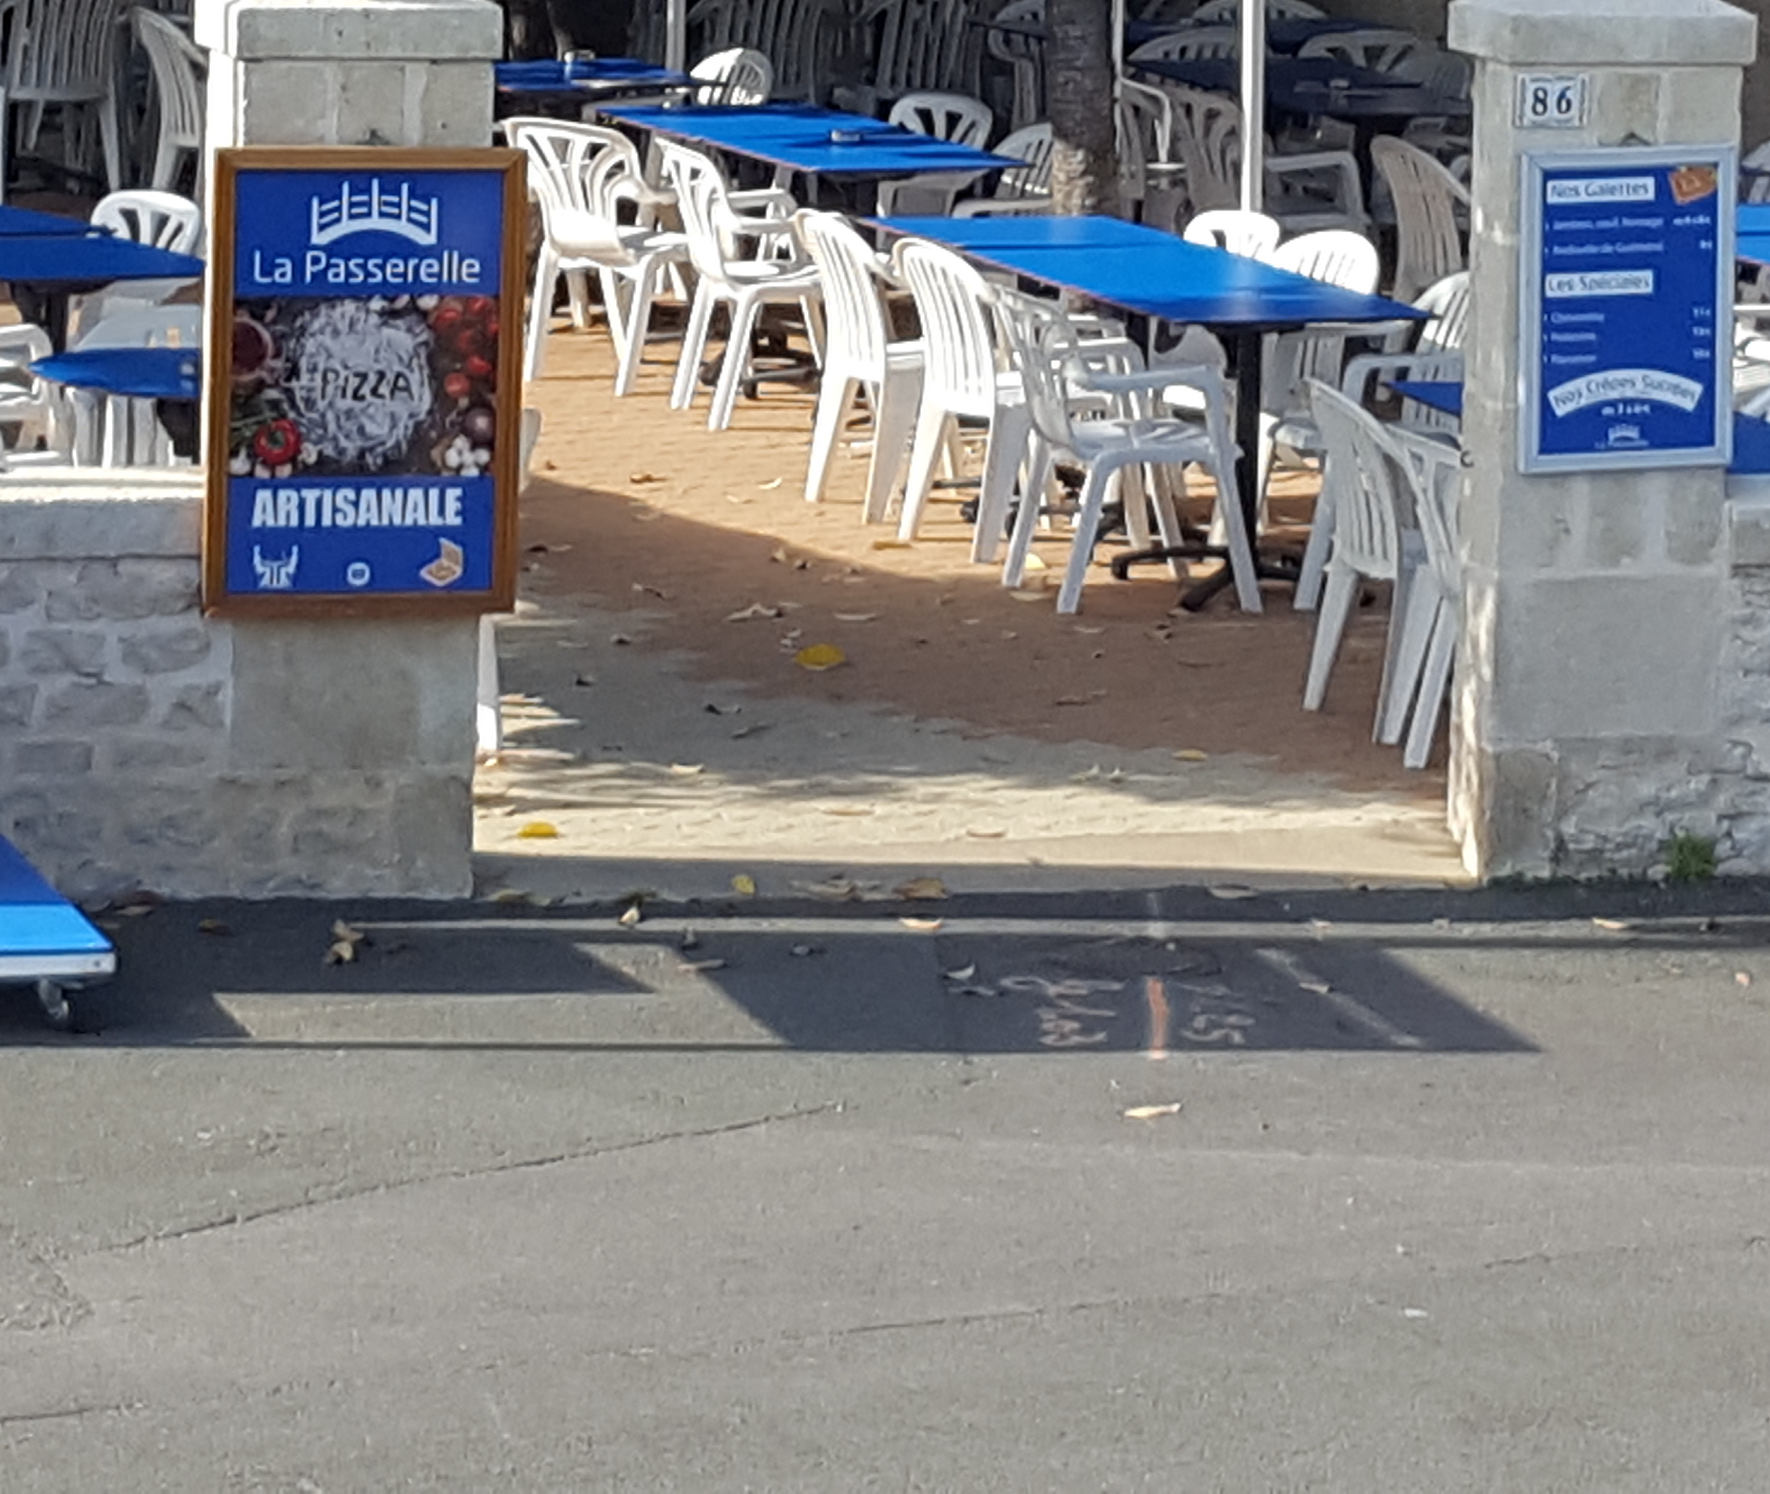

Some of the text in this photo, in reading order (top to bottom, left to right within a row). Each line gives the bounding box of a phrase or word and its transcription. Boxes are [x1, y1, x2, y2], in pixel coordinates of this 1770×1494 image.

[1531, 85, 1572, 117] 86
[253, 249, 481, 285] La Passerelle
[252, 486, 463, 528] ARTISANALE
